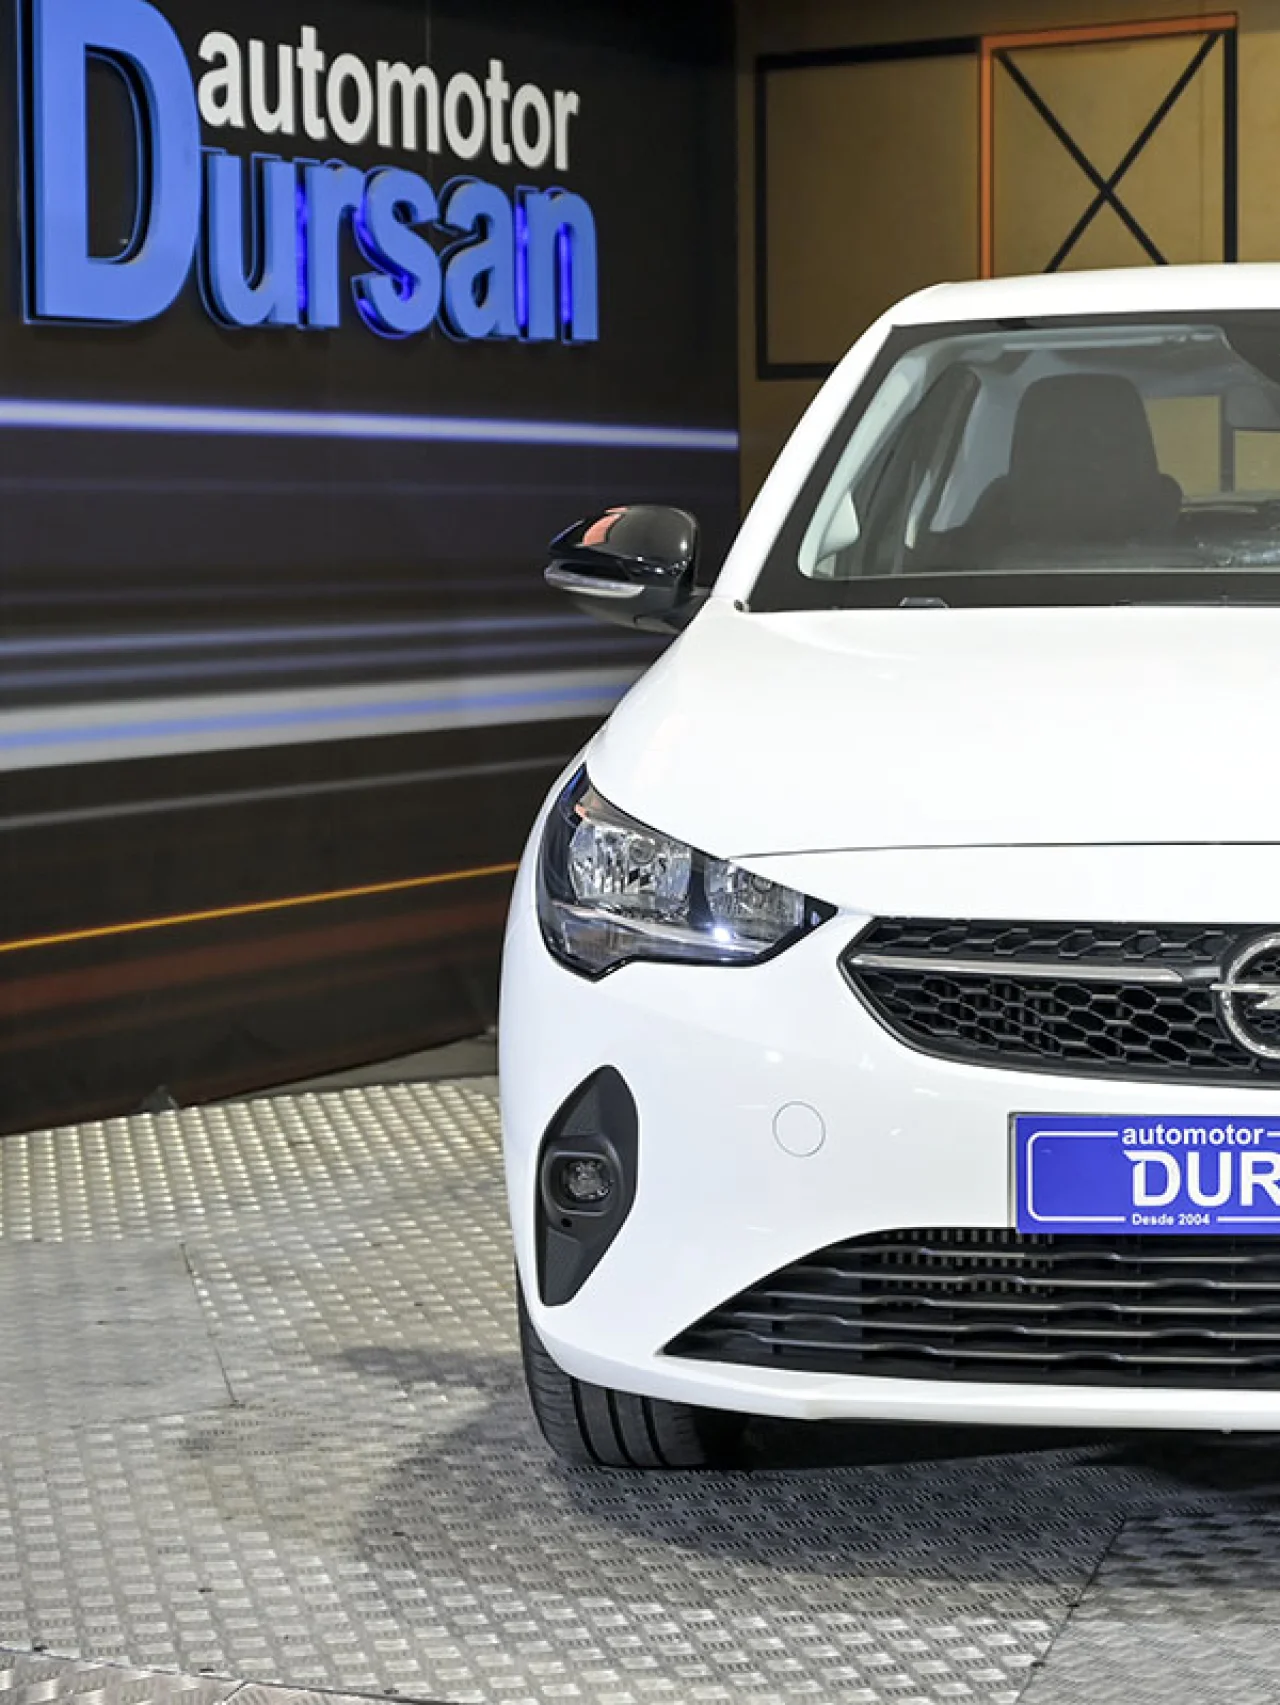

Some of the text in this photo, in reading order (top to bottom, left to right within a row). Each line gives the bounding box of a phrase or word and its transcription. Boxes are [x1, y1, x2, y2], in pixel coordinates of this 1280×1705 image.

[198, 25, 579, 170] automotor
[22, 0, 599, 343] Dursan
[1122, 1124, 1264, 1145] automotor
[1132, 1214, 1210, 1225] Desde 2004
